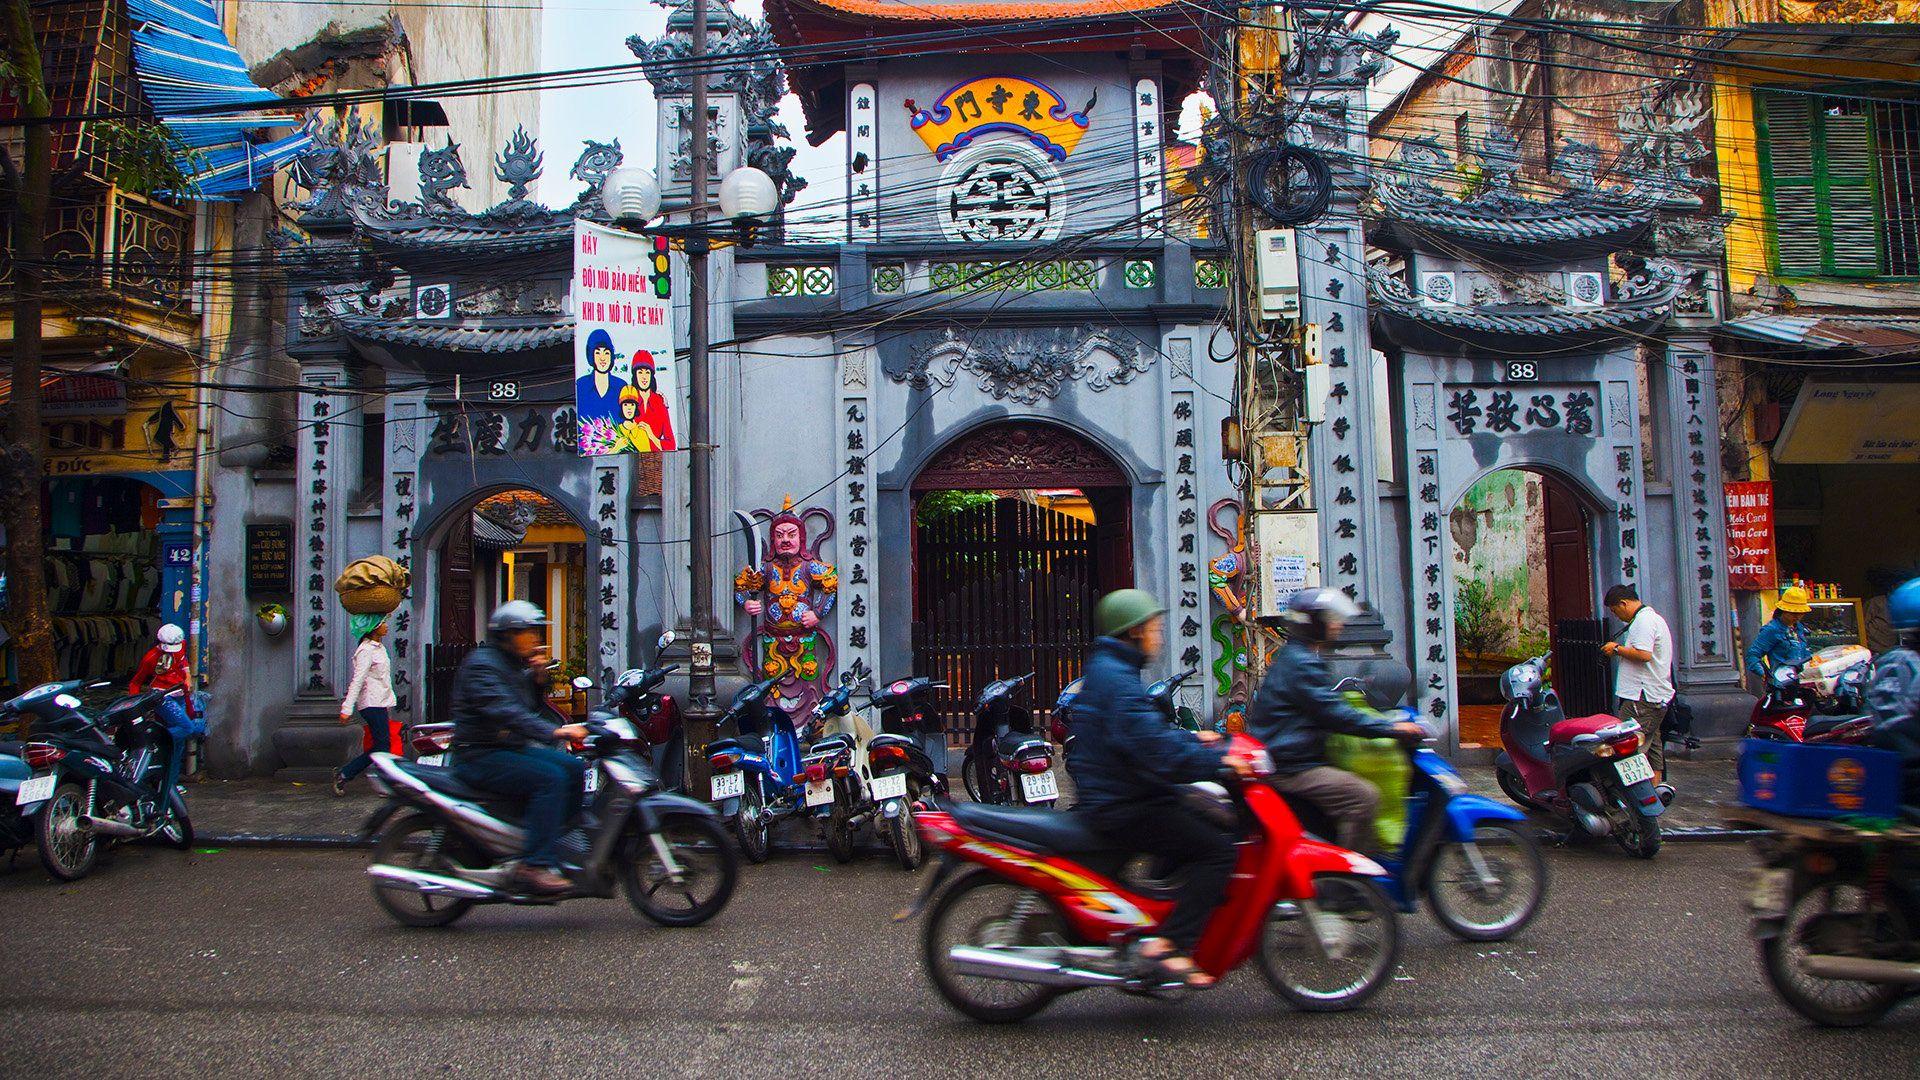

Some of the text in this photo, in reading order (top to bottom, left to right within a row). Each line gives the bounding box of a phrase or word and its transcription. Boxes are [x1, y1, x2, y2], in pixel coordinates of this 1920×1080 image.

[582, 231, 597, 255] HÃY
[582, 265, 647, 293] ĐỘI MŨ BẢO HIỂM
[582, 302, 594, 321] KHI
[596, 303, 604, 321] ĐI
[608, 300, 620, 323] MÔ
[637, 306, 647, 324] XE
[648, 303, 664, 325] MÁY
[1511, 363, 1535, 378] 38
[492, 382, 517, 398] 38
[1740, 491, 1756, 507] BÁN
[1746, 512, 1767, 523] Card
[1747, 527, 1768, 537] Card
[169, 548, 191, 562] 42
[1742, 547, 1770, 556] Fone
[1028, 784, 1052, 797] 4401
